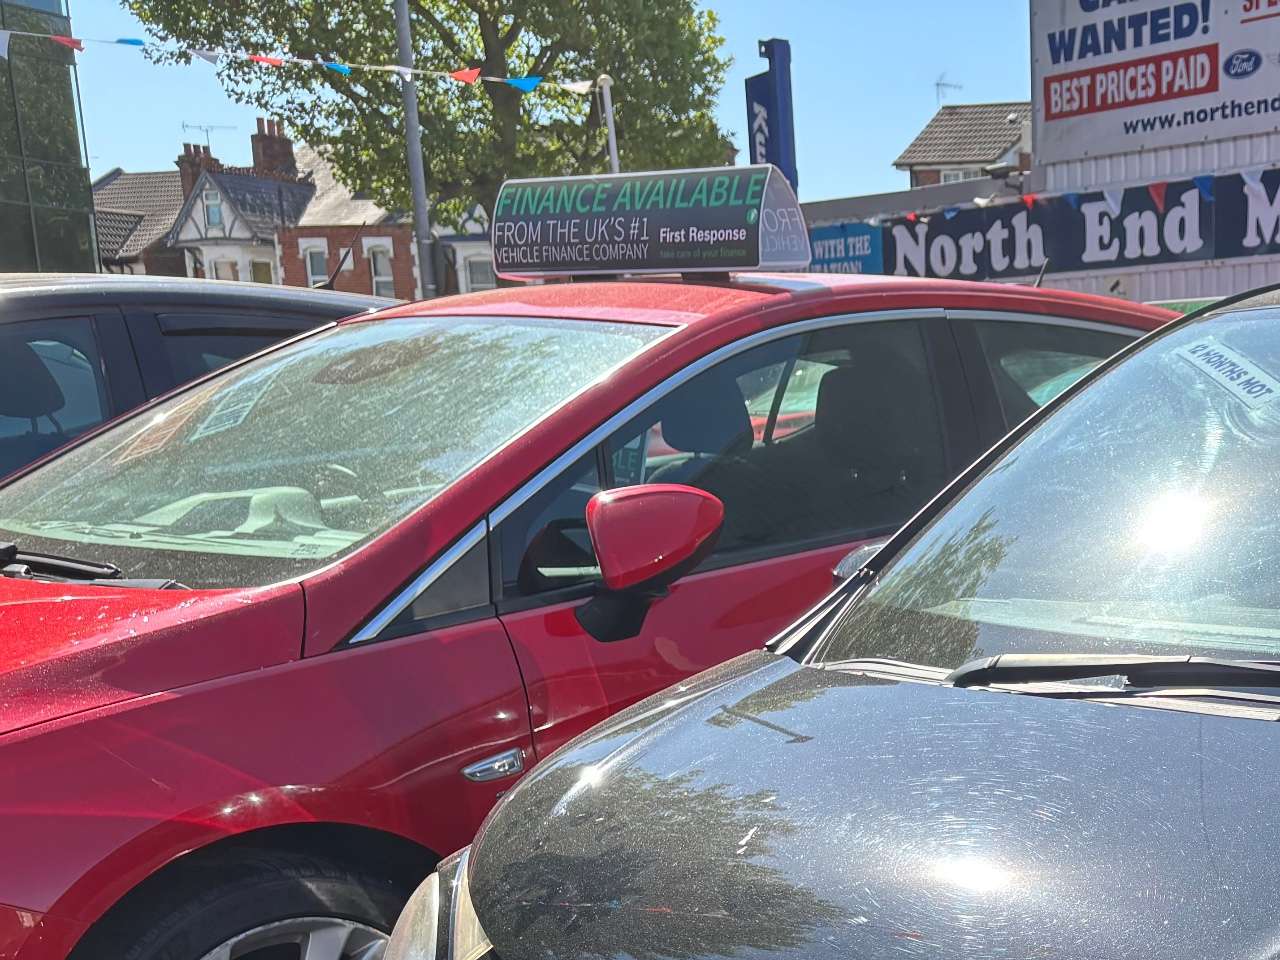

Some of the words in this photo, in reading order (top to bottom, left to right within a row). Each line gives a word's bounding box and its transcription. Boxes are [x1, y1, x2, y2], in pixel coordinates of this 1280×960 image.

[1047, 0, 1211, 65] WANTED!
[1050, 75, 1090, 114] BEST
[1095, 62, 1157, 107] PRICES
[1161, 53, 1210, 94] PAID
[497, 181, 613, 217] FINANCE
[613, 173, 767, 211] AVAILABLE
[495, 220, 541, 245] FROM
[546, 219, 580, 243] THE
[585, 217, 625, 242] UK'S
[630, 217, 649, 240] #1
[495, 246, 540, 263] VEHICLE
[543, 244, 591, 262] FINANCE
[593, 243, 649, 260] COMPANY
[660, 227, 686, 243] First
[689, 226, 747, 245] Response
[813, 238, 845, 259] WITH
[847, 235, 872, 257] THE
[891, 211, 1047, 278] North
[1080, 187, 1204, 263] End
[1197, 349, 1249, 382] MONTHS
[1237, 376, 1275, 399] MOT
